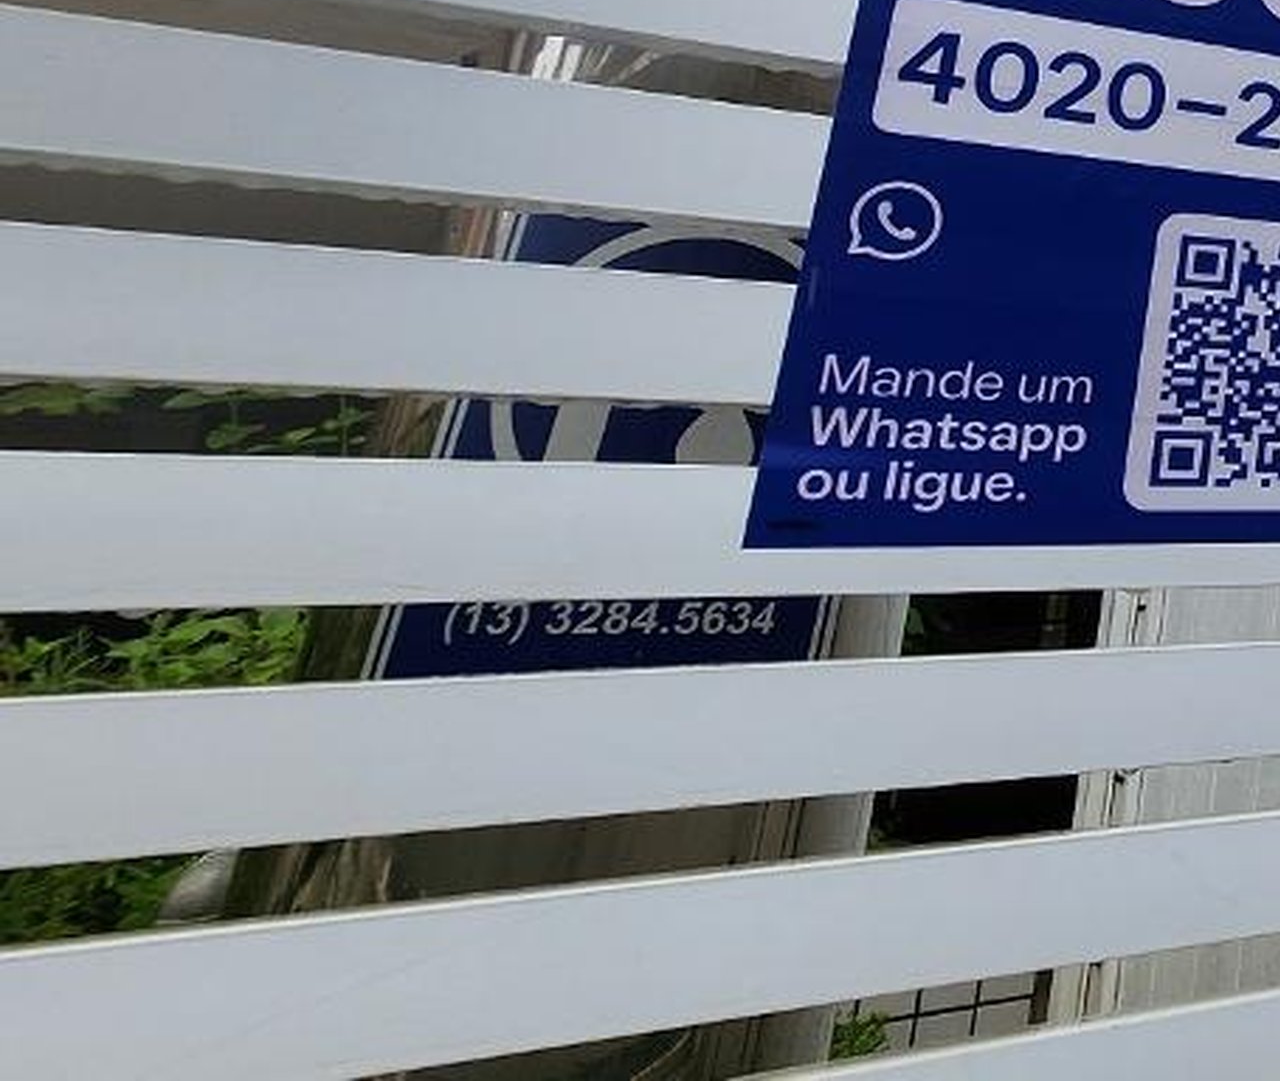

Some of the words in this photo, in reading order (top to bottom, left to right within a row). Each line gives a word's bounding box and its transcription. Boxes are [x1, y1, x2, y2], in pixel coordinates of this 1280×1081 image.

[818, 353, 1004, 401] Mande
[1017, 373, 1093, 404] um
[810, 405, 1088, 462] Whatsapp
[796, 469, 870, 501] ou
[883, 460, 1027, 513] ligue.
[443, 600, 531, 646] (13)
[544, 600, 777, 635] 3284.5634
